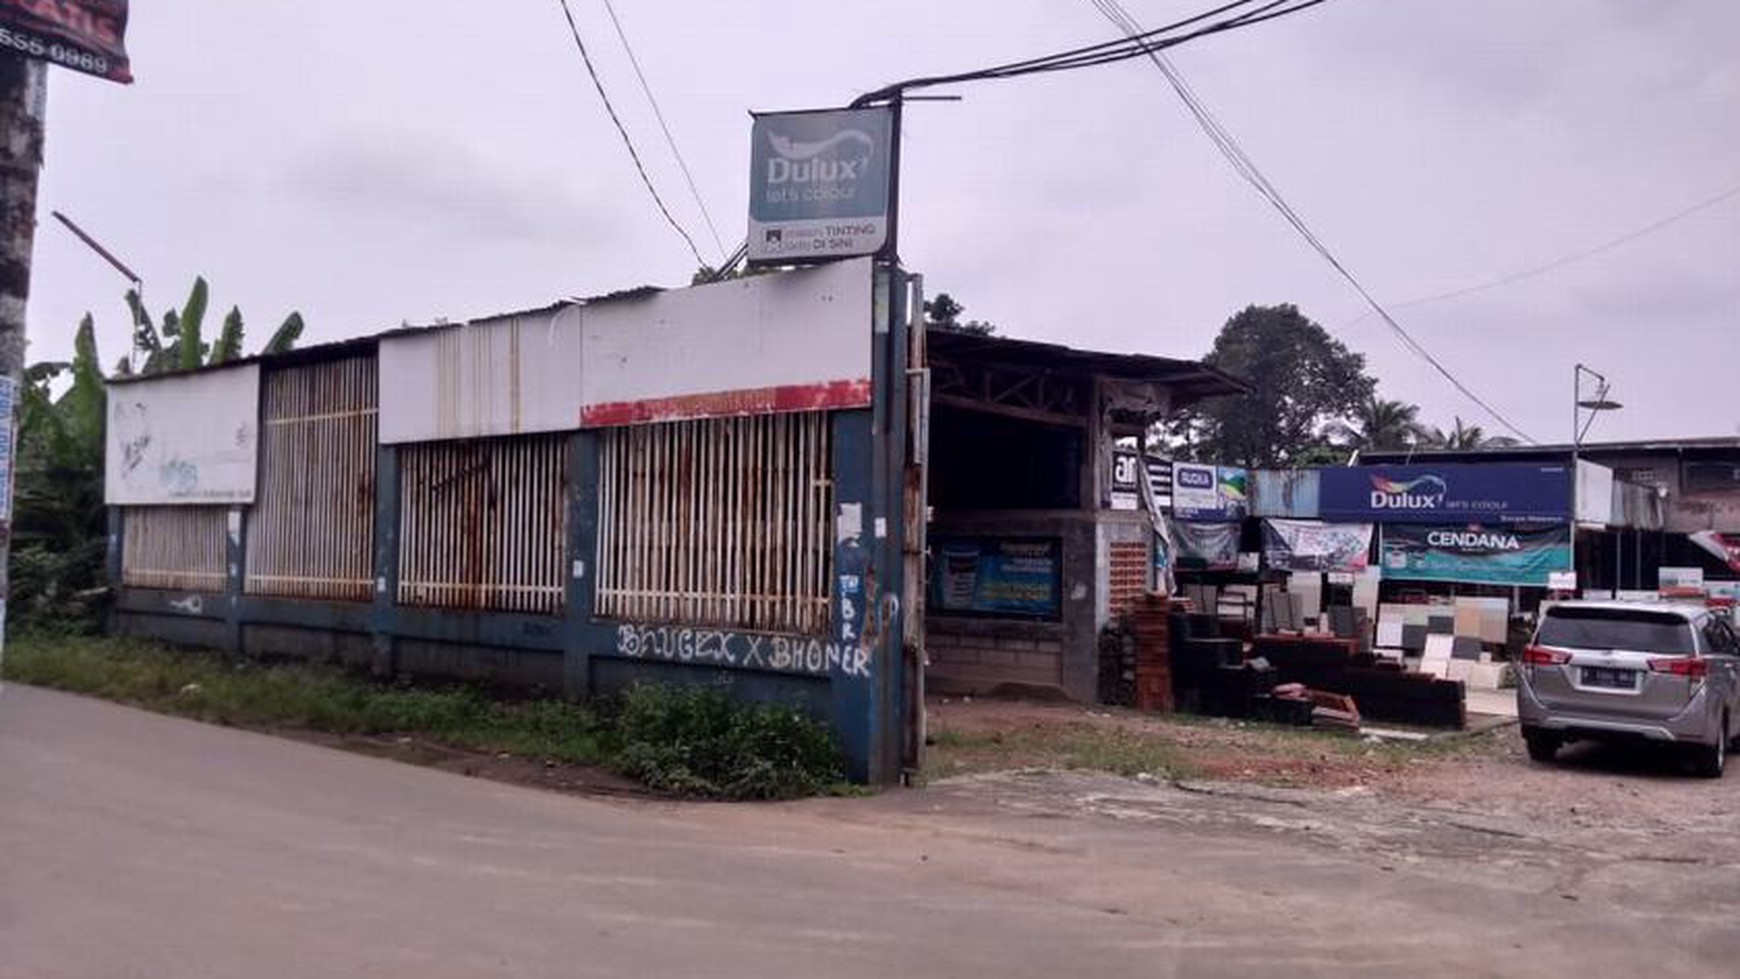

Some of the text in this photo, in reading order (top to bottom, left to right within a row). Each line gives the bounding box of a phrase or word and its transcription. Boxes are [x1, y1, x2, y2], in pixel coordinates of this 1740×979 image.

[767, 158, 857, 184] Dulux
[1371, 491, 1435, 509] Dulux
[1427, 531, 1520, 550] CENDANA
[743, 635, 764, 667] X
